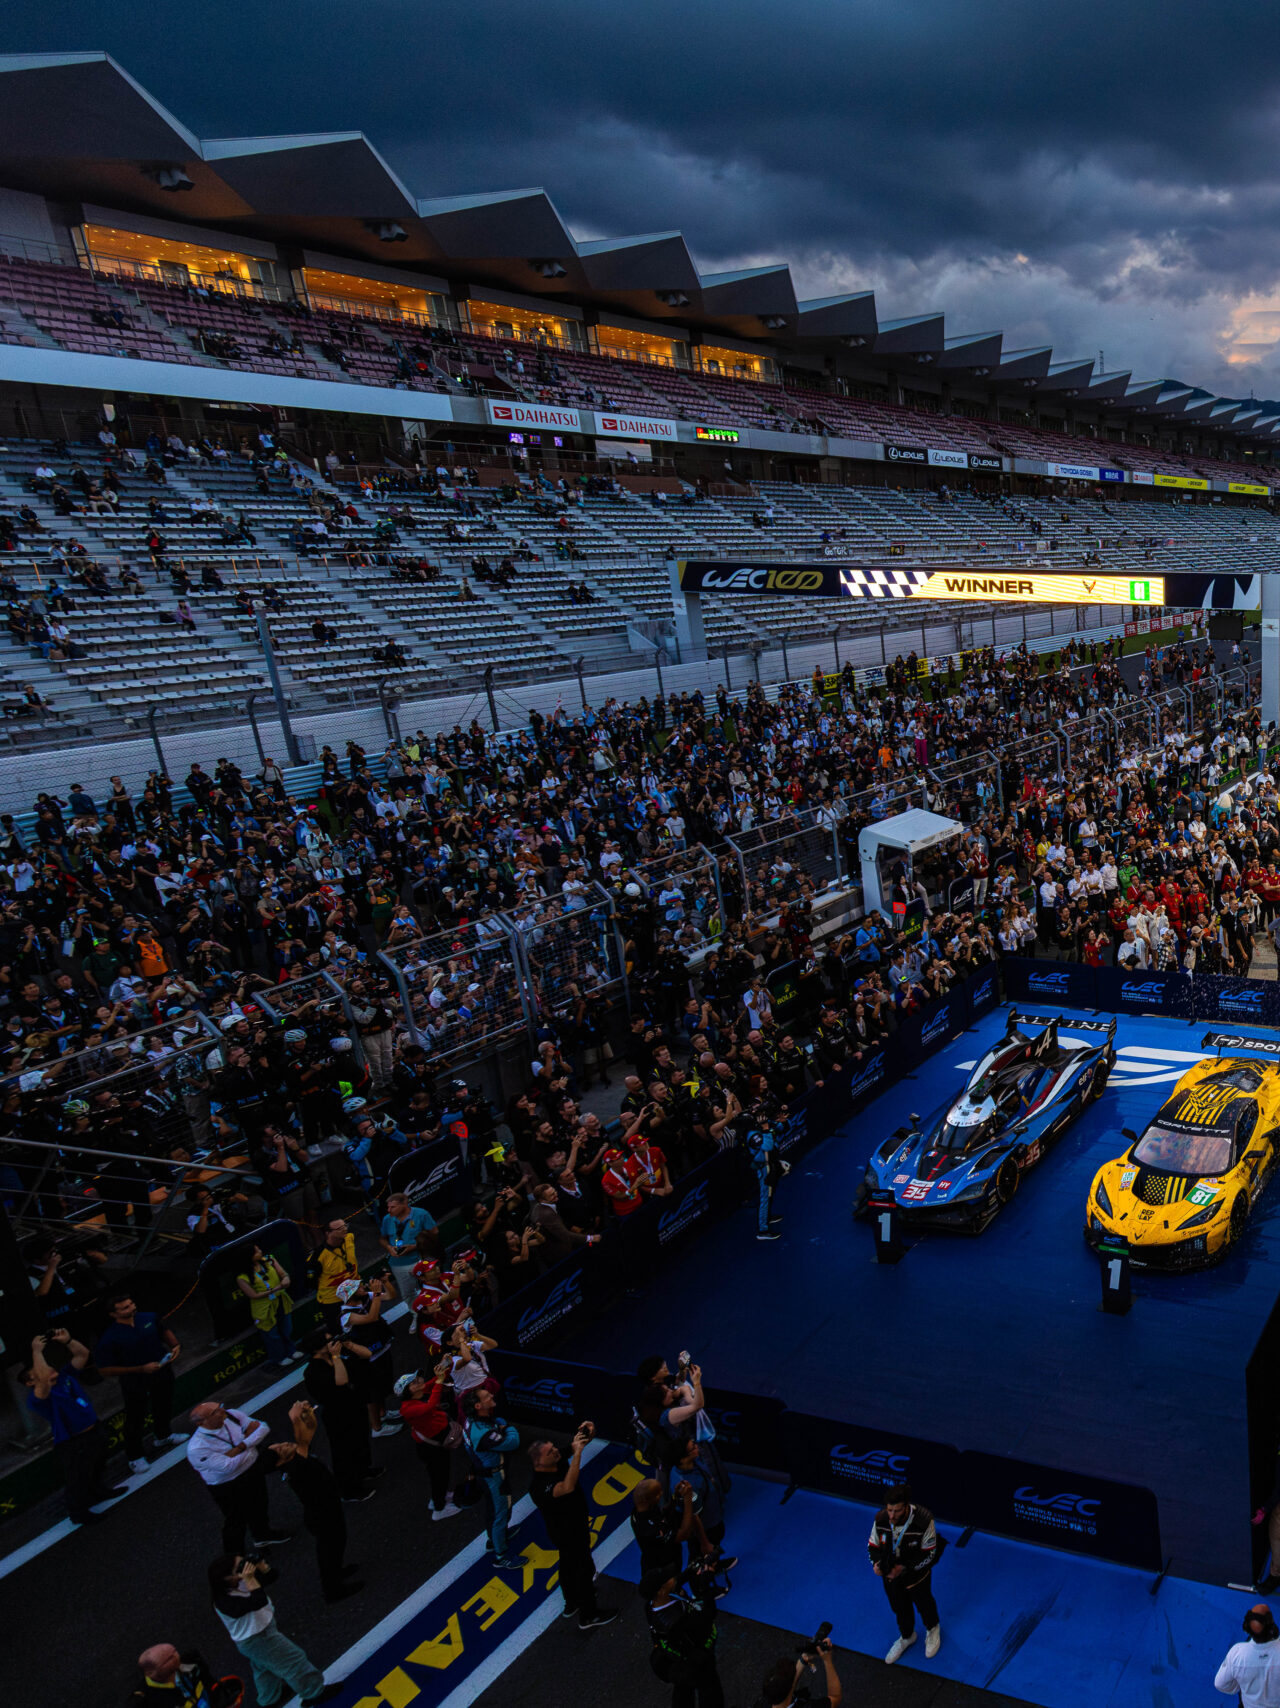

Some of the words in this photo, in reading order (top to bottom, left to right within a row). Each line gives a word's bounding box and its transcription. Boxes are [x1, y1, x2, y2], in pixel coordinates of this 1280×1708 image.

[278, 408, 288, 421] H
[514, 408, 579, 427] DAIHATSU
[619, 419, 672, 436] DAIHATSU
[898, 450, 925, 461] LEXUS
[940, 454, 964, 464] LEXUS
[978, 458, 1000, 467] LEXUS
[944, 578, 1034, 595] WINNER
[902, 1185, 928, 1200] 35
[937, 1181, 952, 1189] HY
[1190, 1189, 1212, 1205] 81
[877, 1212, 892, 1243] 1
[1107, 1259, 1122, 1290] 1
